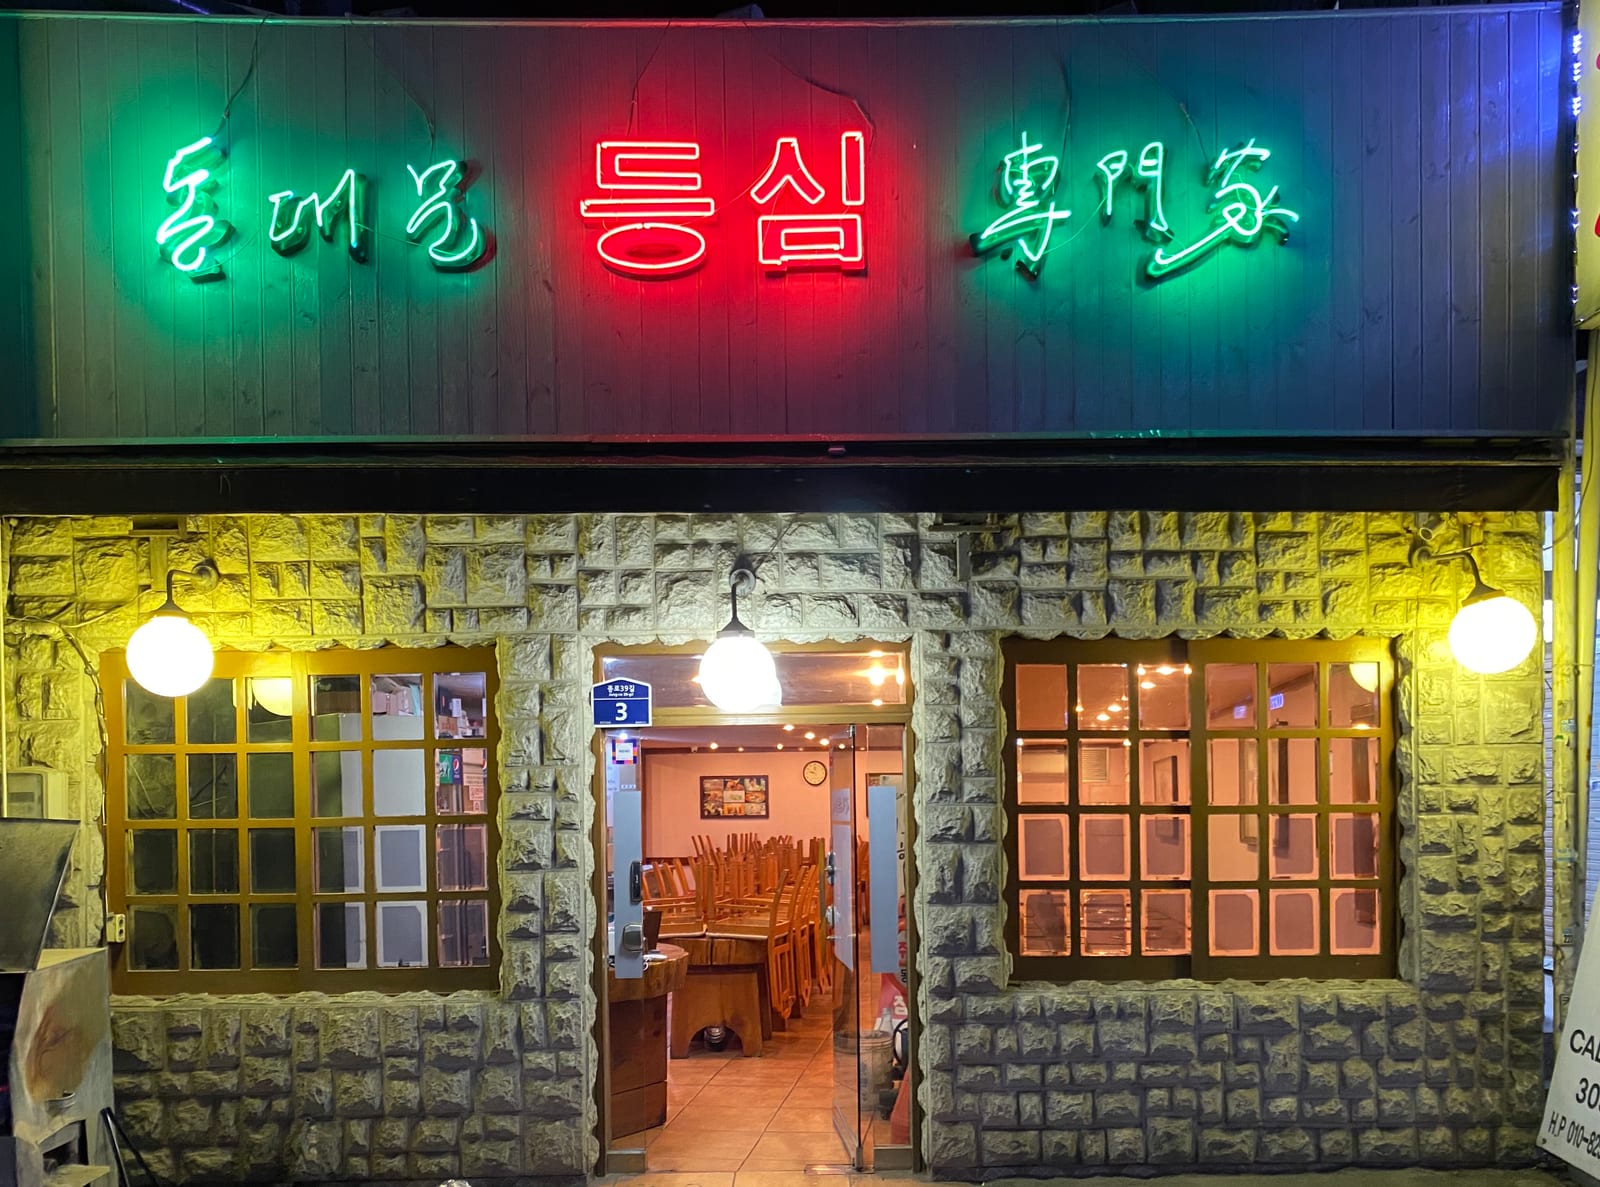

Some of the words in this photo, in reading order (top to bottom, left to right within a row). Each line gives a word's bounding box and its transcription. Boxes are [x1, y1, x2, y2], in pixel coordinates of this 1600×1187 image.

[580, 131, 865, 270] 등심
[981, 131, 1300, 265] 專門家
[615, 702, 628, 721] 3
[1575, 1077, 1600, 1112] 30
[1566, 1120, 1600, 1160] 010-82
